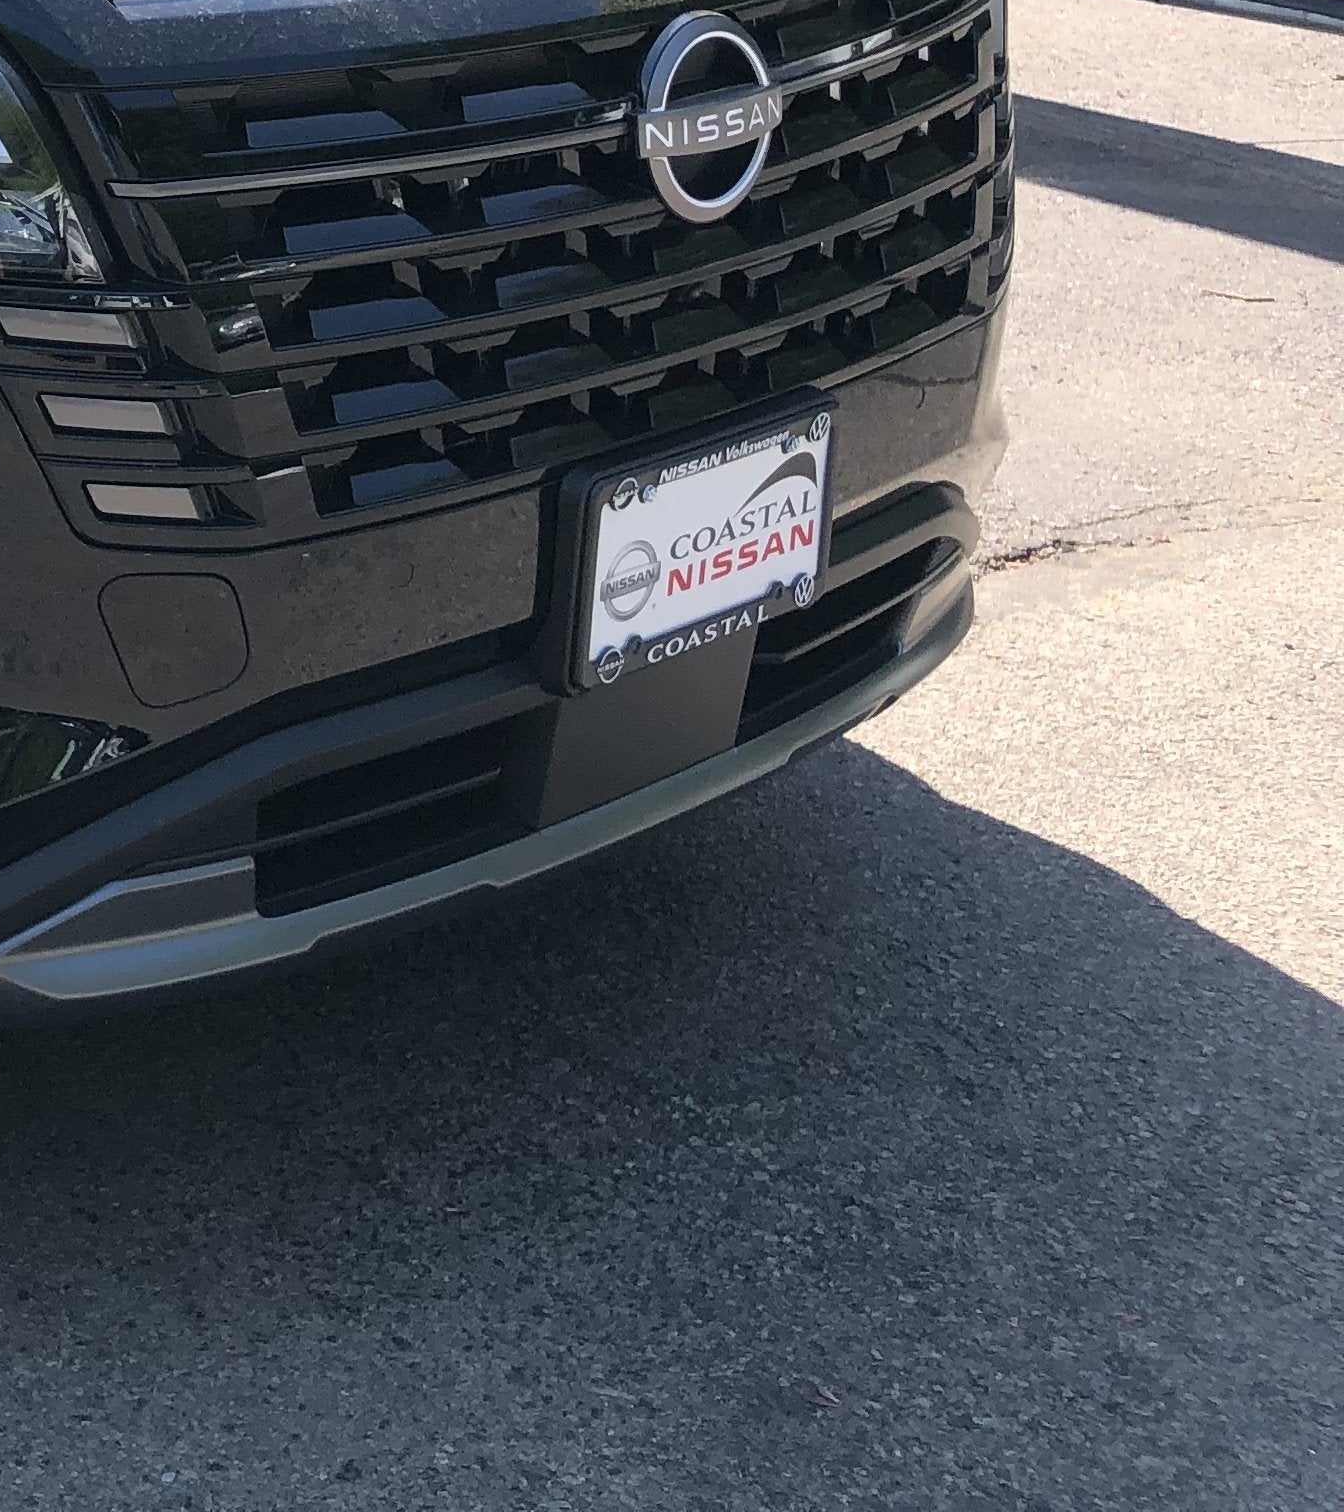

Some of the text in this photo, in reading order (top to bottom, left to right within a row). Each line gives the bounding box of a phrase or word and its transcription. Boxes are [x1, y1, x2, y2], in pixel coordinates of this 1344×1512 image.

[646, 94, 781, 149] NISSAN
[659, 451, 722, 484] NISSAN
[670, 490, 816, 559] COASTAL
[606, 568, 654, 594] NISSAN
[667, 519, 814, 596] NISSAN
[647, 605, 768, 663] COASTAL
